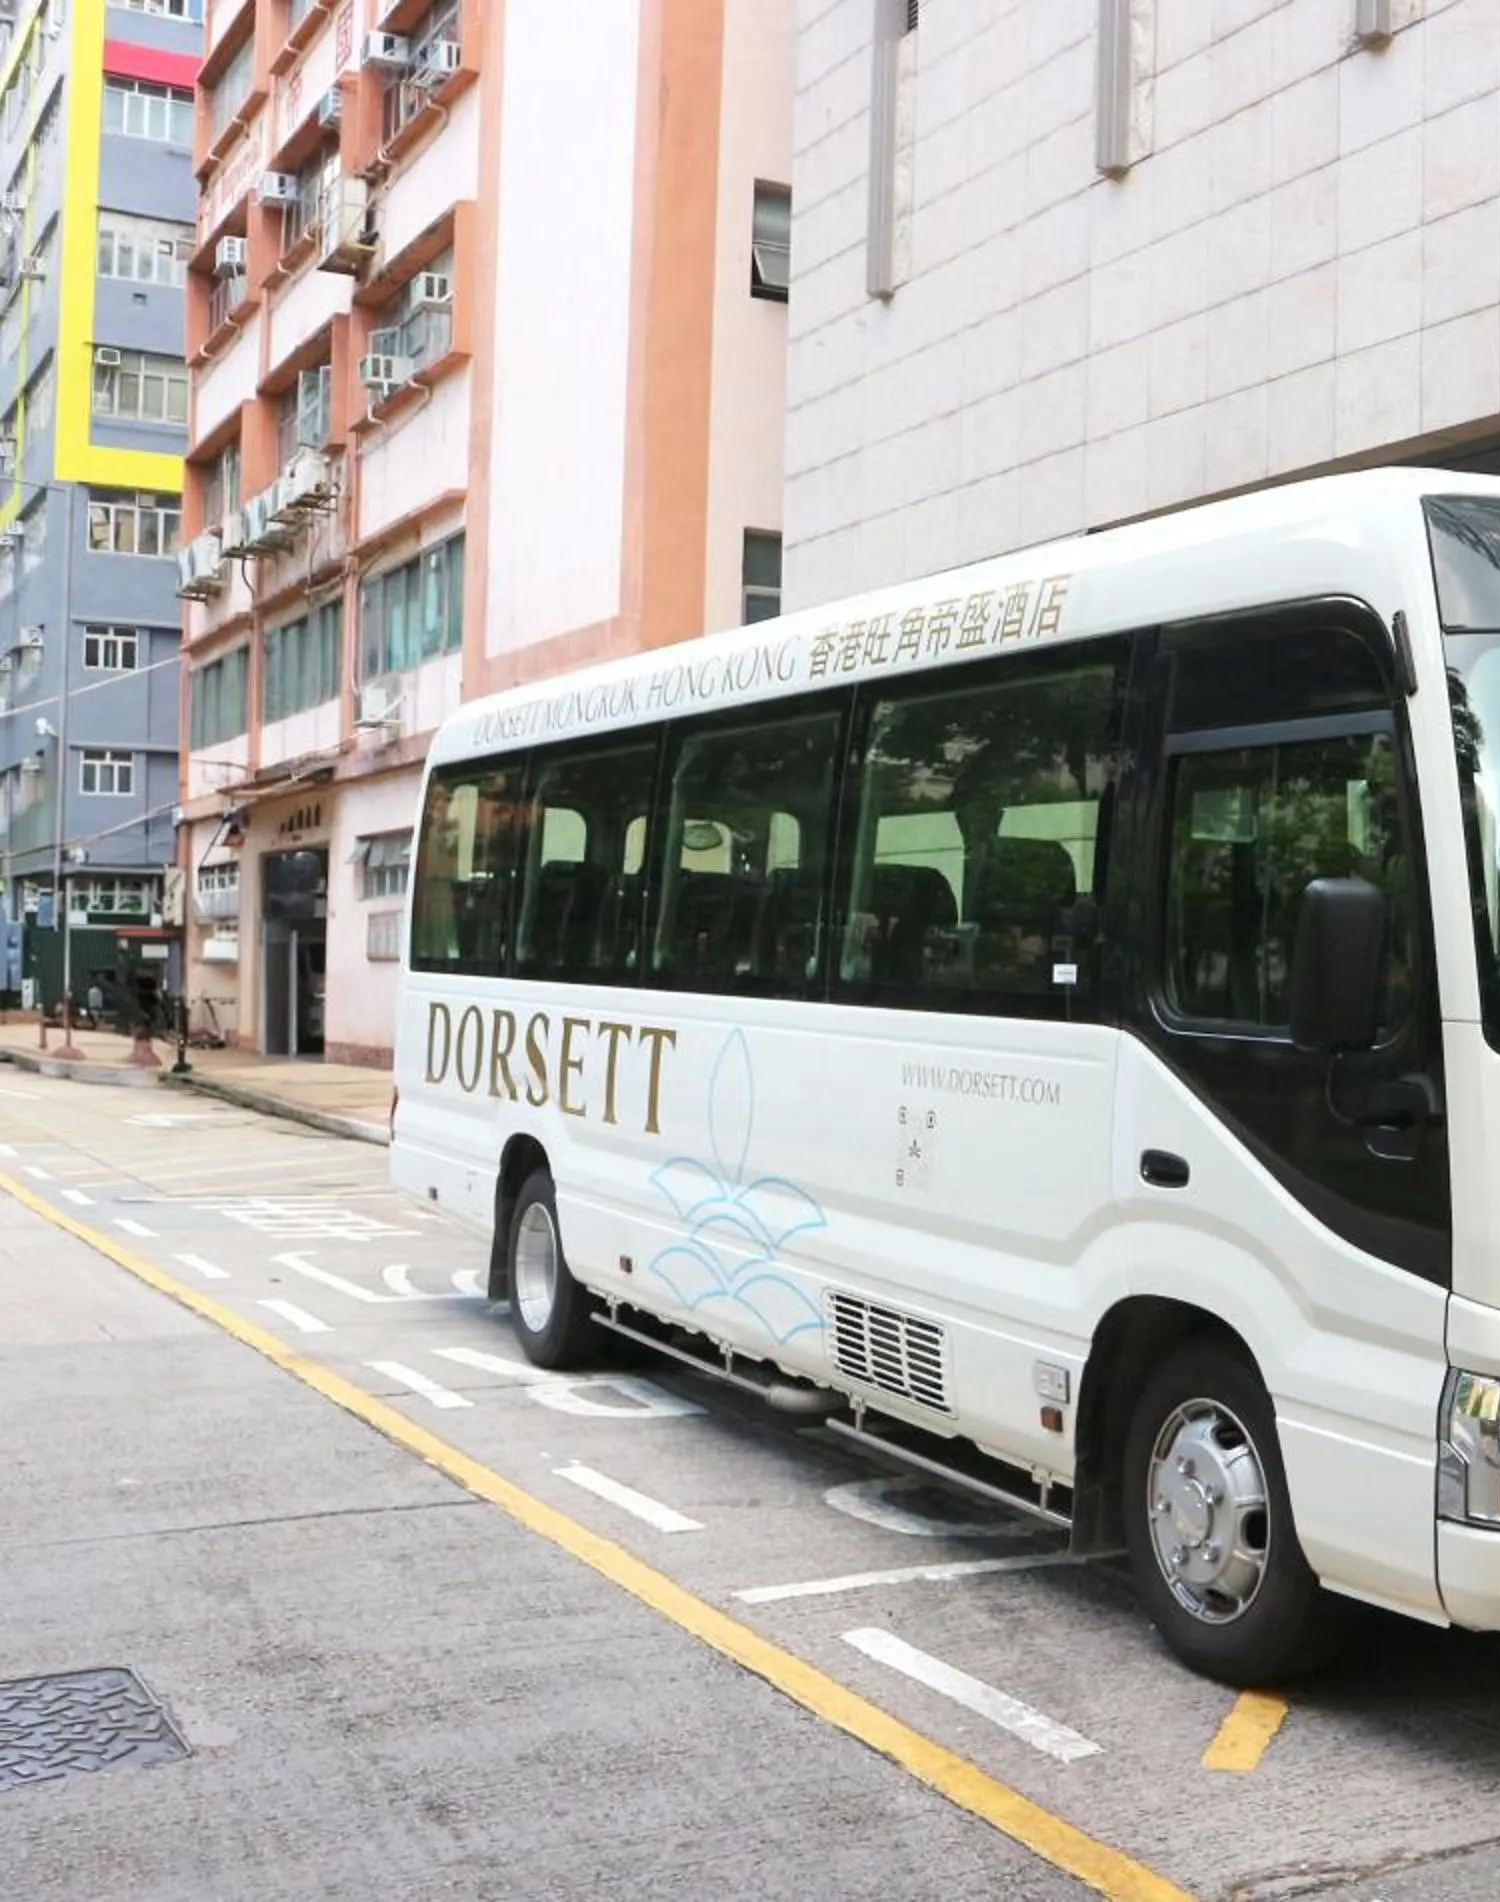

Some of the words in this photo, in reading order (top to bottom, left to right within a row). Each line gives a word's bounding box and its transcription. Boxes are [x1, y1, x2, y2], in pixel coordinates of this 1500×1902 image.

[645, 655, 721, 708] HONG
[721, 635, 801, 692] KONG
[809, 573, 1073, 680] 香港旺角帝盛酒店
[425, 1001, 678, 1134] DORSETT
[902, 1063, 1061, 1106] WWW.DORSETT.COM
